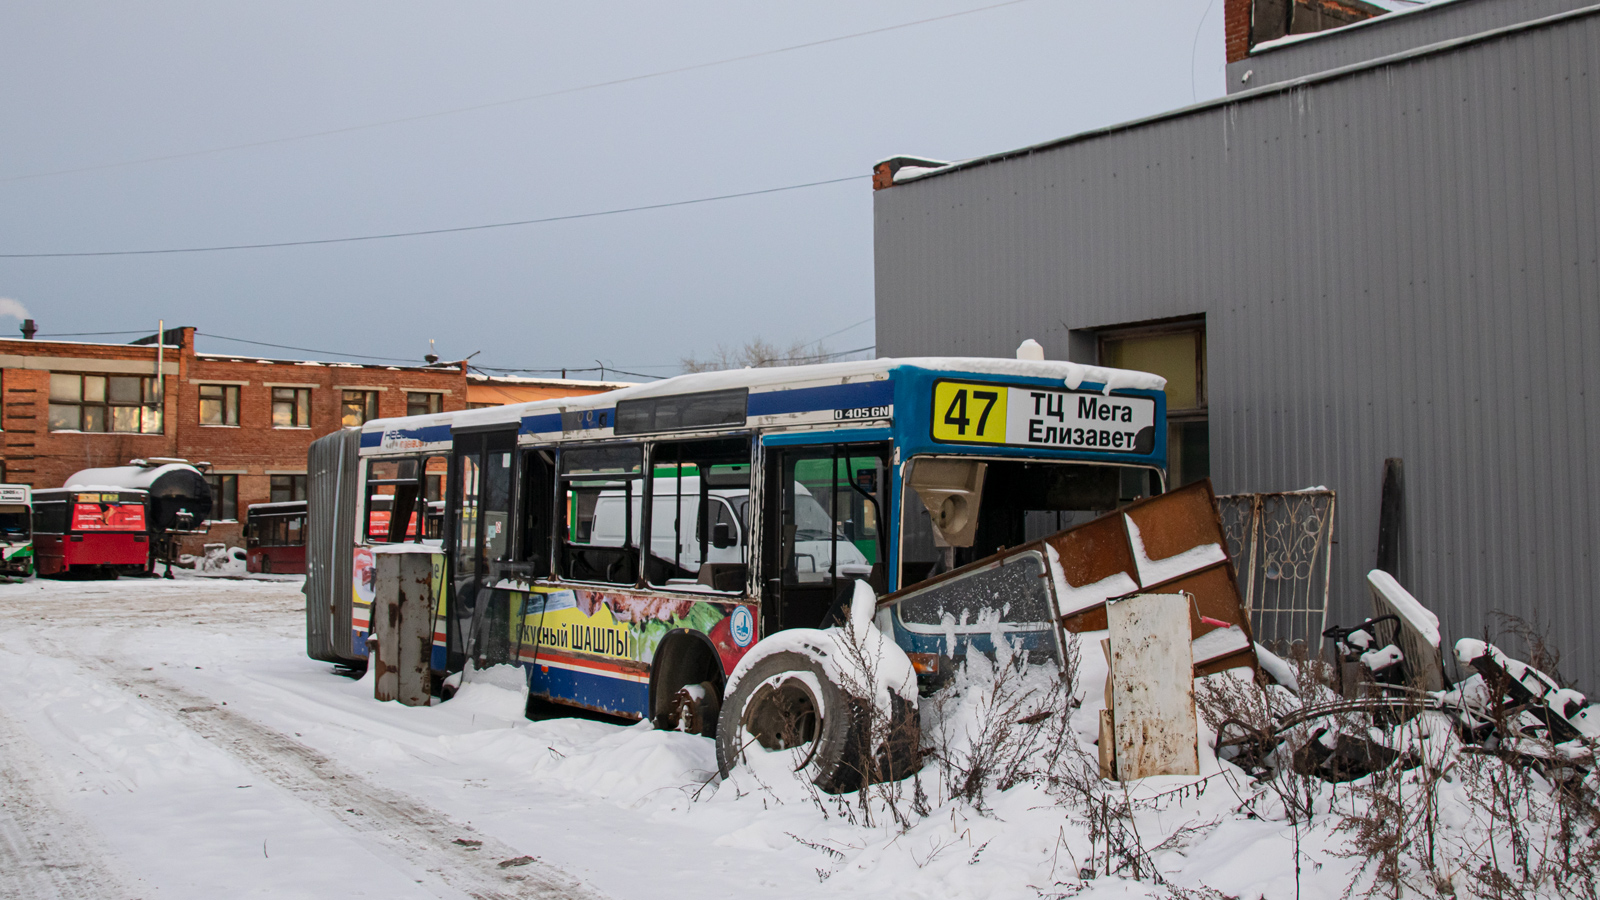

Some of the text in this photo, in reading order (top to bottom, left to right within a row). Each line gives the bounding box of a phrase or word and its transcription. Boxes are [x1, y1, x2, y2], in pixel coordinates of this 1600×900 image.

[845, 407, 870, 418] 405
[871, 406, 889, 417] GN
[944, 389, 998, 436] 47
[1030, 392, 1132, 422] ТЦ Мега
[1028, 419, 1135, 449] Елизавет
